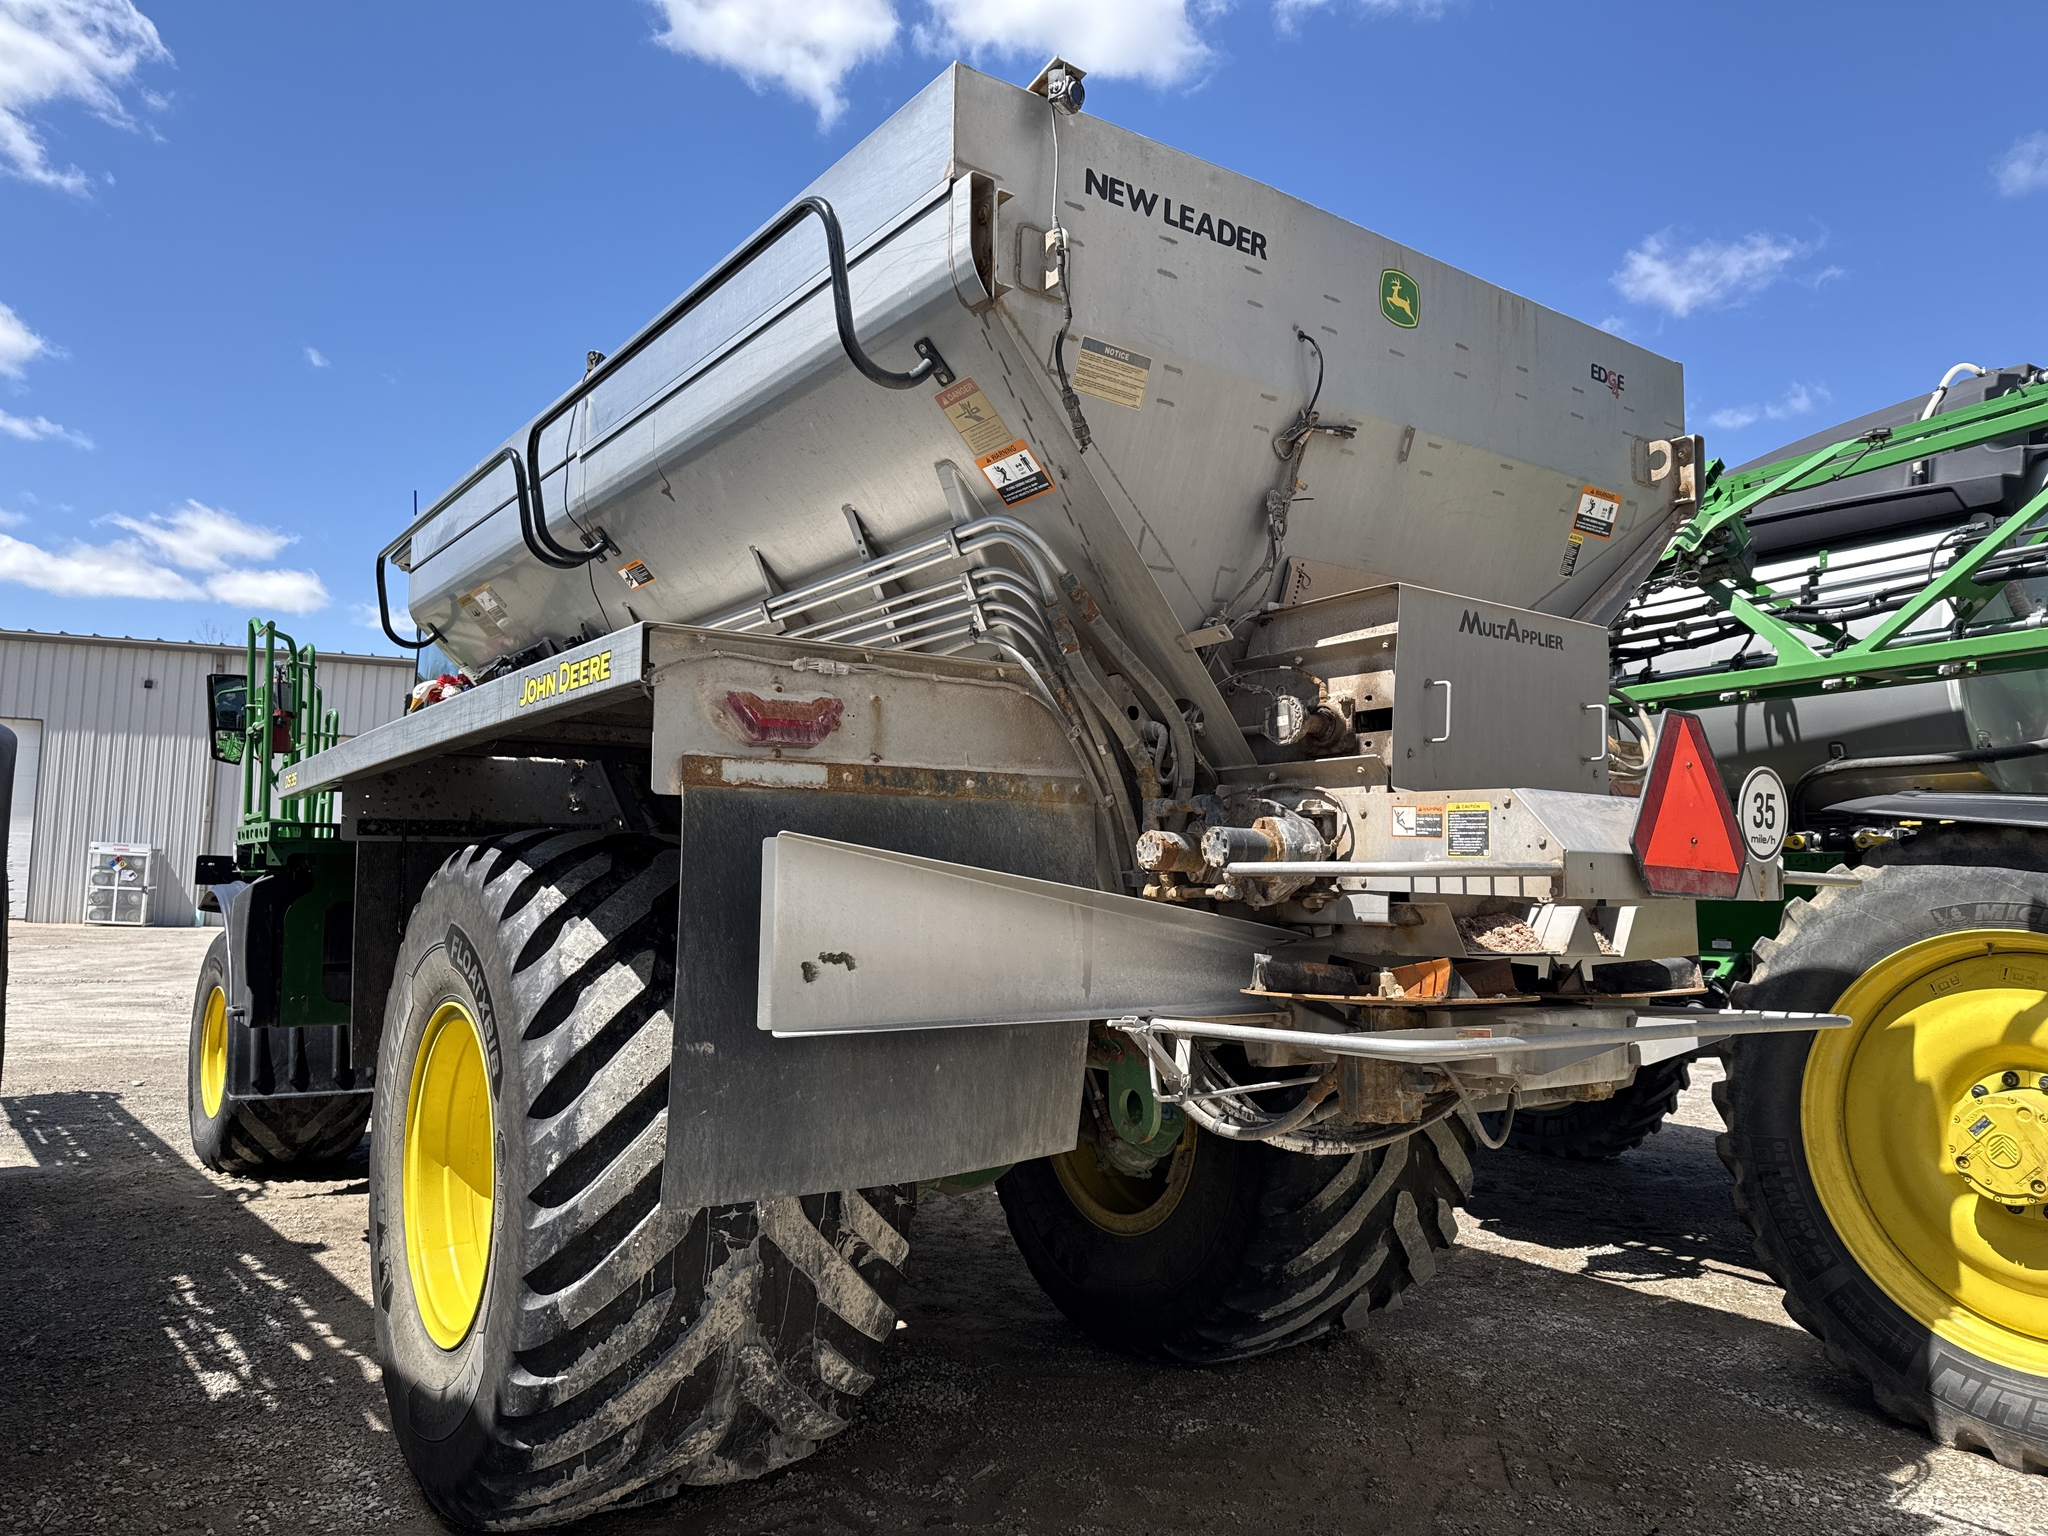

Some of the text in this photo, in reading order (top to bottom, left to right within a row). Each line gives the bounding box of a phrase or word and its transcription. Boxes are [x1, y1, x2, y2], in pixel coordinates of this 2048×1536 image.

[1085, 167, 1268, 261] NEW LEADER
[1104, 346, 1130, 361] NOTICE
[1591, 363, 1625, 392] EDGE
[946, 382, 975, 402] DANGER
[989, 444, 1017, 461] WARNING
[1595, 489, 1615, 501] WARNING
[519, 649, 612, 707] JOHN DEERE
[1752, 791, 1776, 830] 35
[1751, 834, 1776, 845] mile/h
[1975, 904, 2048, 925] MIC
[1966, 1112, 1979, 1124] TOP
[1772, 1140, 1787, 1162] 50
[1783, 1182, 1818, 1240] 420/95
